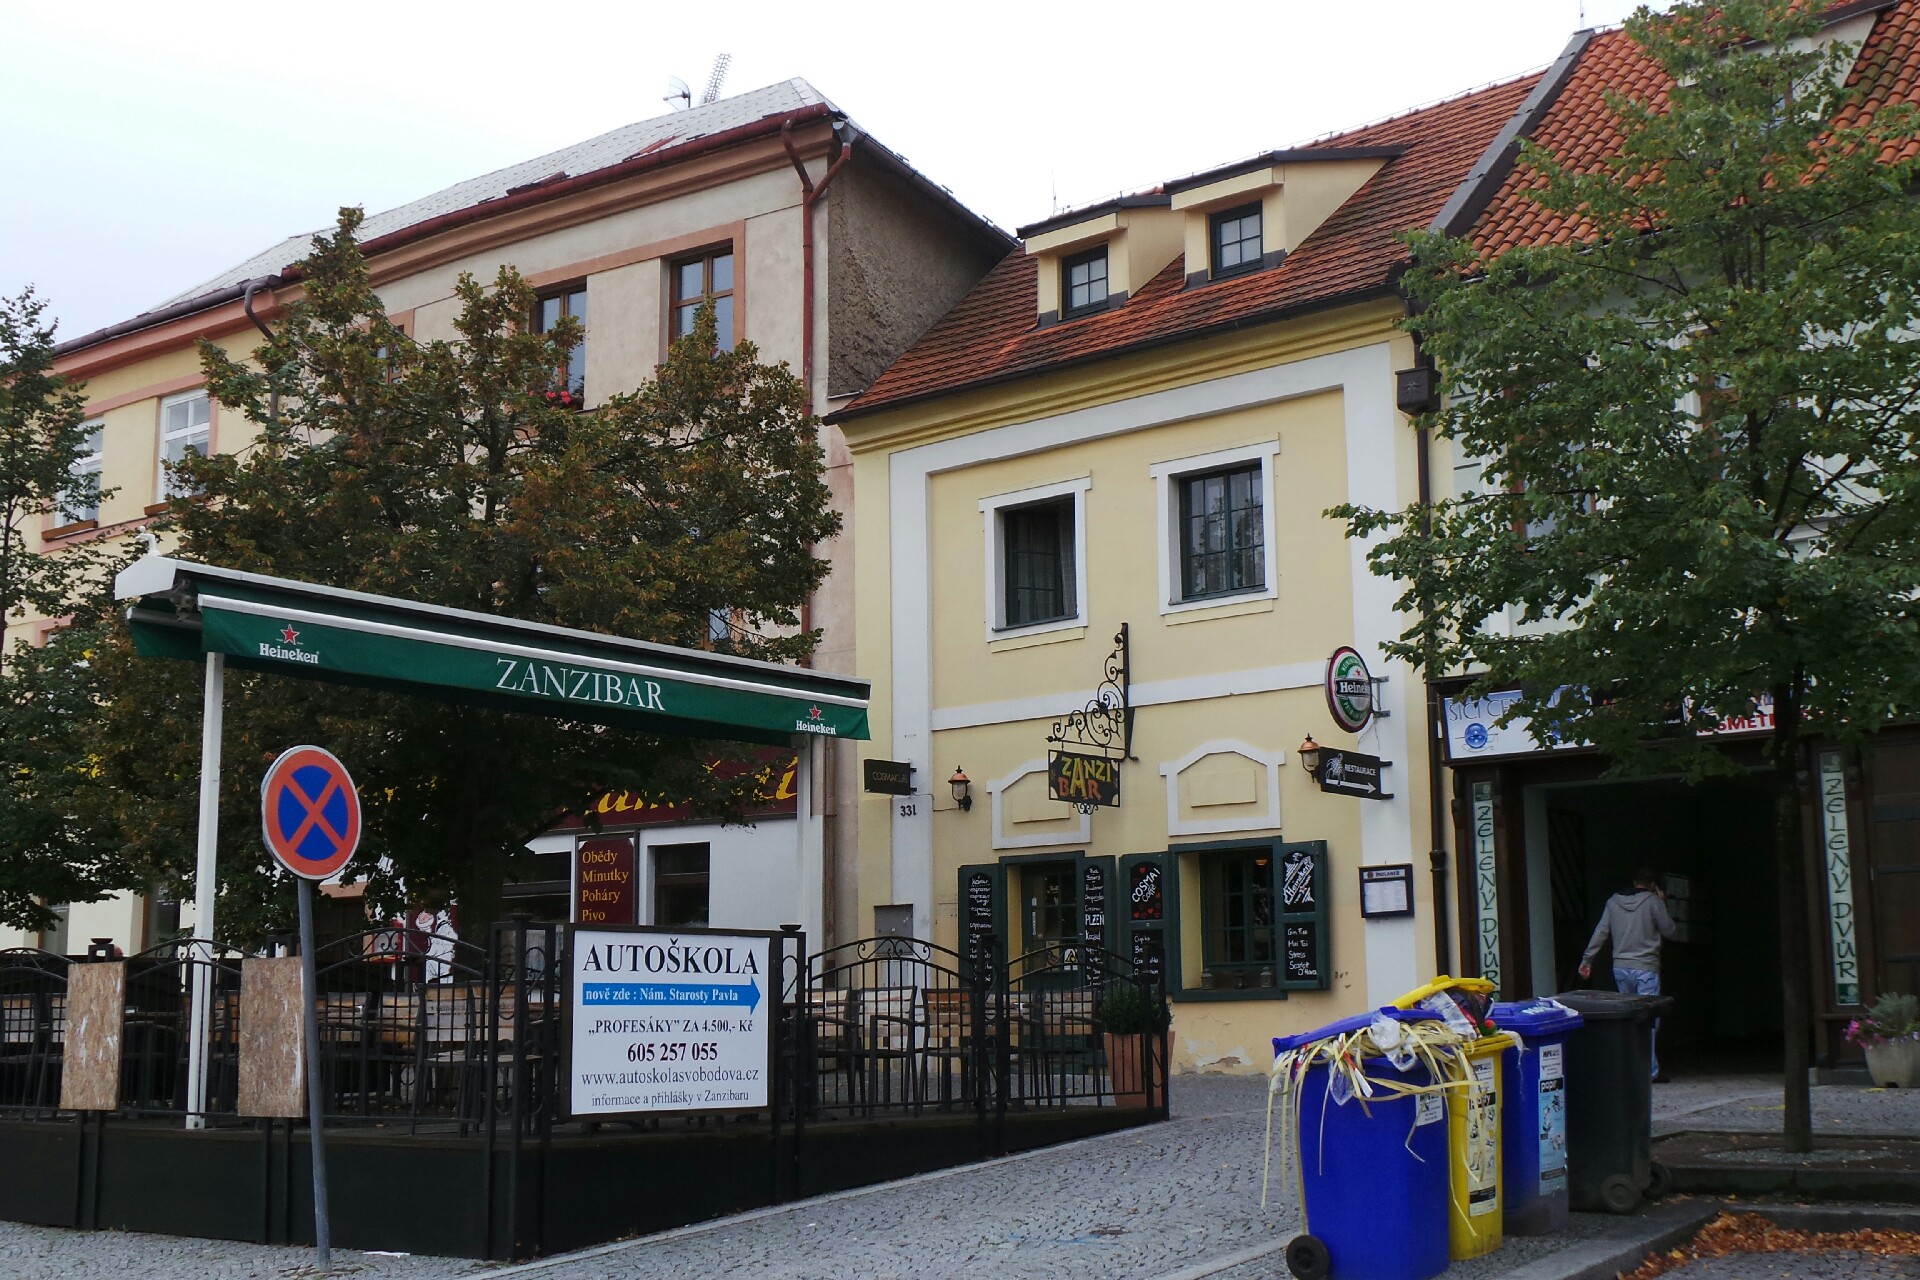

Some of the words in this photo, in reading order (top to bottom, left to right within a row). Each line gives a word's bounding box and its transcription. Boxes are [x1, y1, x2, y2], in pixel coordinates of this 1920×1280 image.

[259, 643, 319, 664] Heineken
[495, 658, 666, 711] ZANZIBAR
[795, 720, 837, 735] Heineken
[1061, 756, 1111, 784] ZANZI
[1344, 763, 1376, 776] RESTAURACE
[900, 804, 917, 817] 331
[582, 850, 618, 865] Obědy
[582, 869, 629, 885] Minutky
[582, 889, 621, 904] Poháry
[582, 909, 606, 921] Pivo
[583, 938, 760, 974] AUTOŠKOLA
[585, 988, 610, 1000] nově
[612, 988, 631, 1000] zde
[640, 987, 666, 1001] Nám.
[669, 987, 709, 1004] Starosty
[712, 989, 738, 1001] Pavla
[683, 1020, 699, 1033] ZA
[739, 1019, 753, 1032] Kč
[627, 1043, 655, 1062] 605
[659, 1043, 687, 1061] 257
[691, 1042, 718, 1060] 055
[581, 1066, 760, 1086] www.autoskolasvobodova.cz
[592, 1093, 641, 1107] informace
[651, 1090, 694, 1107] přihlášky
[704, 1089, 749, 1102] Zanzibaru
